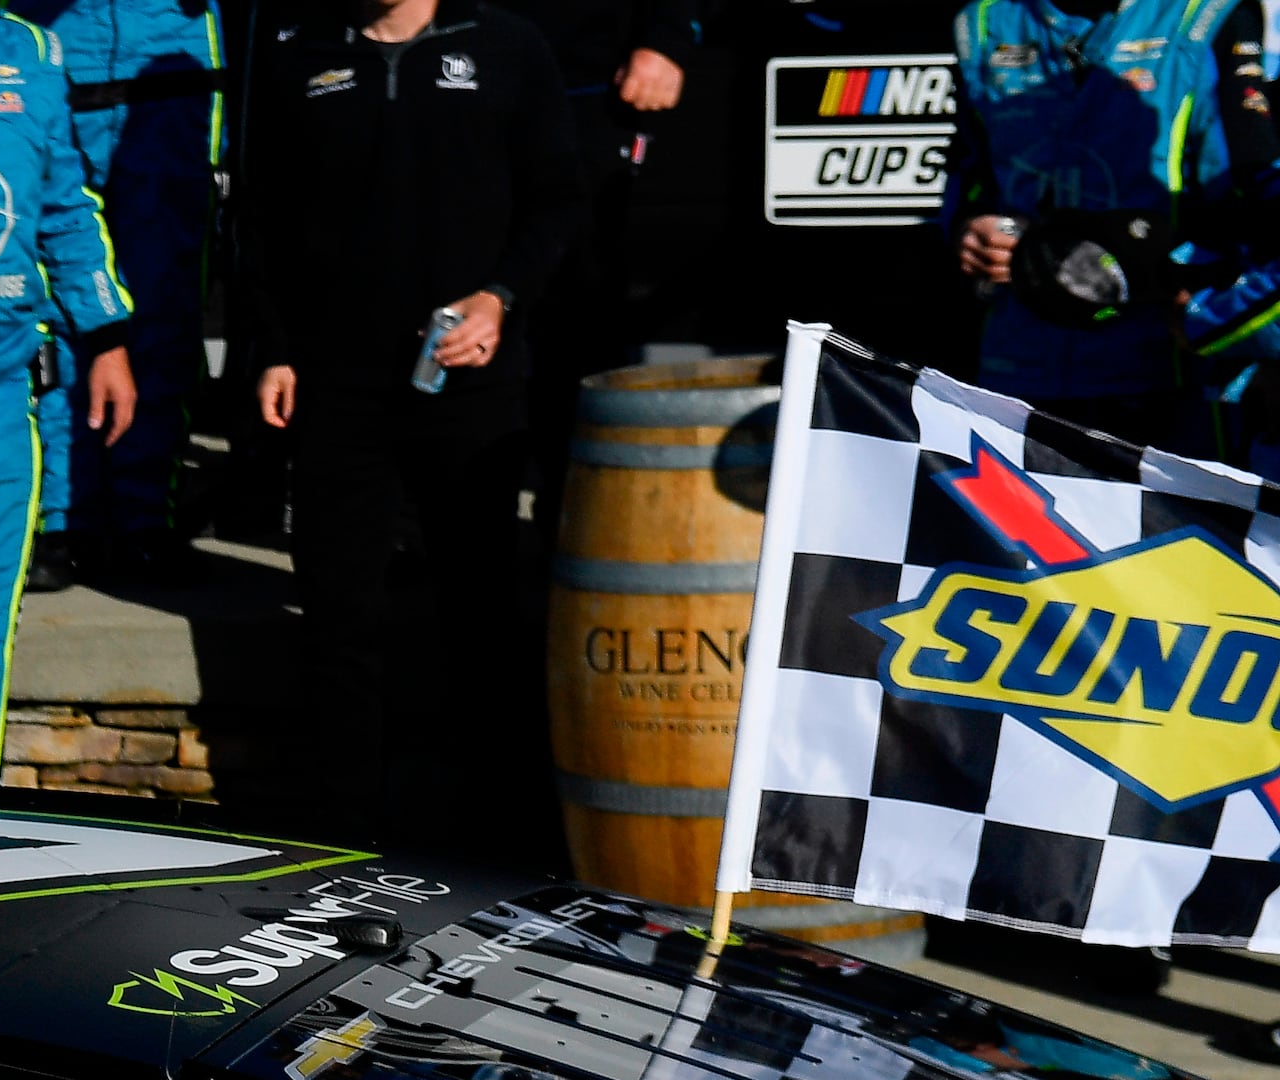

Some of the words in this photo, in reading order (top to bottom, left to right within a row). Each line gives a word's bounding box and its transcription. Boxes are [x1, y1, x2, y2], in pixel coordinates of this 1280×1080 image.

[818, 147, 908, 185] CUP
[910, 588, 1280, 724] SUNO
[384, 896, 610, 1010] CHEVROLET
